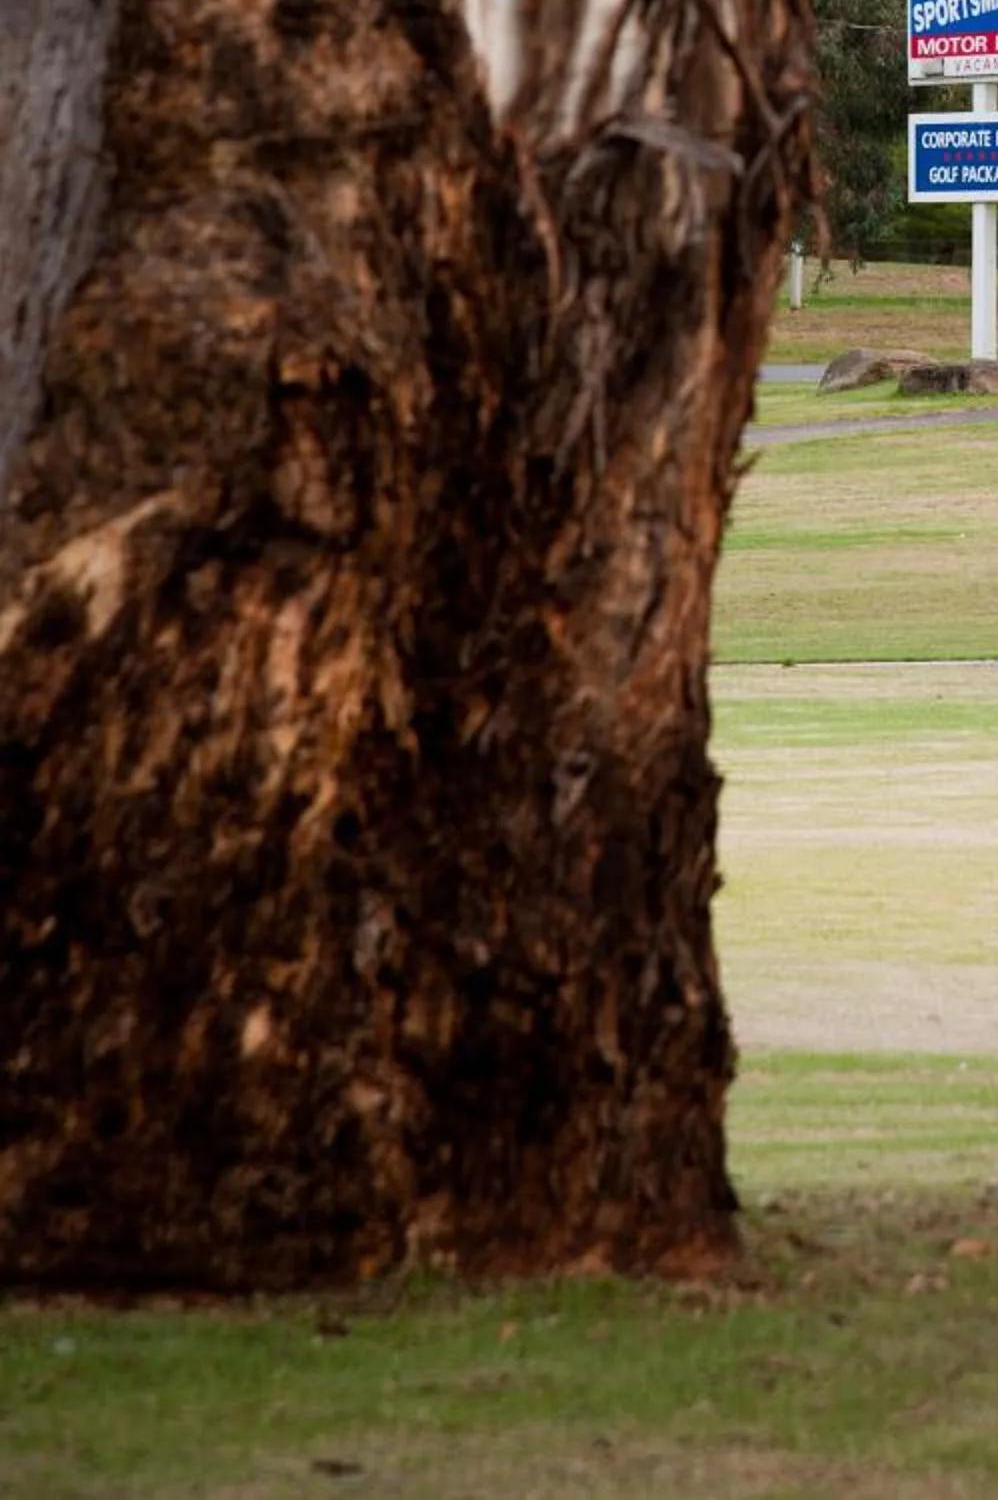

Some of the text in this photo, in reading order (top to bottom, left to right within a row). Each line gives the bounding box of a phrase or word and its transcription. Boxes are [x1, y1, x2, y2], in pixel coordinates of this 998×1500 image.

[917, 35, 988, 55] MOTOR
[921, 129, 991, 149] CORPORATE
[928, 166, 959, 184] GOLF
